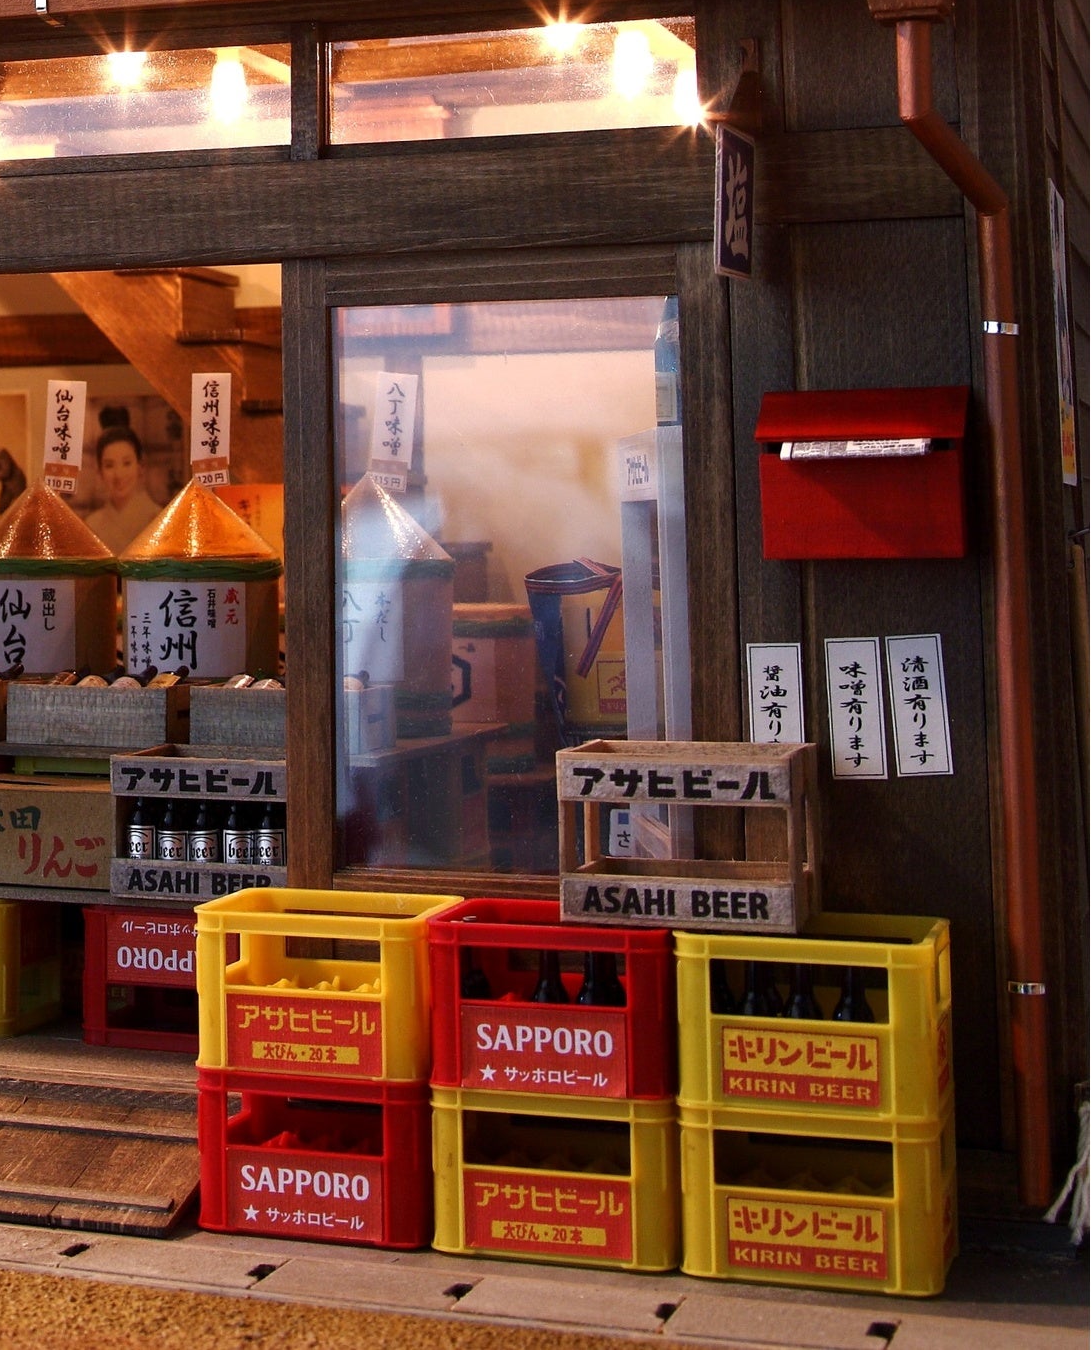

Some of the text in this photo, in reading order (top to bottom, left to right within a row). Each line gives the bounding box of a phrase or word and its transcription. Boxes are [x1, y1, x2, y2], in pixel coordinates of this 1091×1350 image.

[725, 152, 749, 257] 塩
[52, 389, 74, 460] 仙台味噌
[201, 380, 220, 454] 信州味噌
[382, 383, 405, 456] 八丁味噌
[42, 588, 56, 631] 蔵出し
[223, 587, 239, 626] 蔵元
[0, 588, 31, 664] 仙台
[159, 589, 198, 670] 信州
[760, 665, 788, 743] 醤油有り
[839, 661, 869, 768] 味噌有ります
[901, 655, 935, 766] 清酒有ります
[121, 767, 277, 795] アサヒビール
[573, 767, 776, 800] アサヒビール
[18, 833, 106, 878] りんご
[128, 868, 200, 894] ASAHI
[582, 885, 769, 920] ASAHI BEER
[117, 946, 196, 972] PPORO
[236, 1005, 375, 1035] アサヒビール
[476, 1023, 613, 1057] SAPPORO
[728, 1035, 874, 1071] キリンビール
[729, 1076, 872, 1101] KIRIN BEER
[240, 1164, 370, 1201] SAPPORO
[474, 1182, 624, 1216] アサヒビール
[733, 1206, 879, 1243] キリンビール
[734, 1246, 878, 1273] KIRIN BEER
